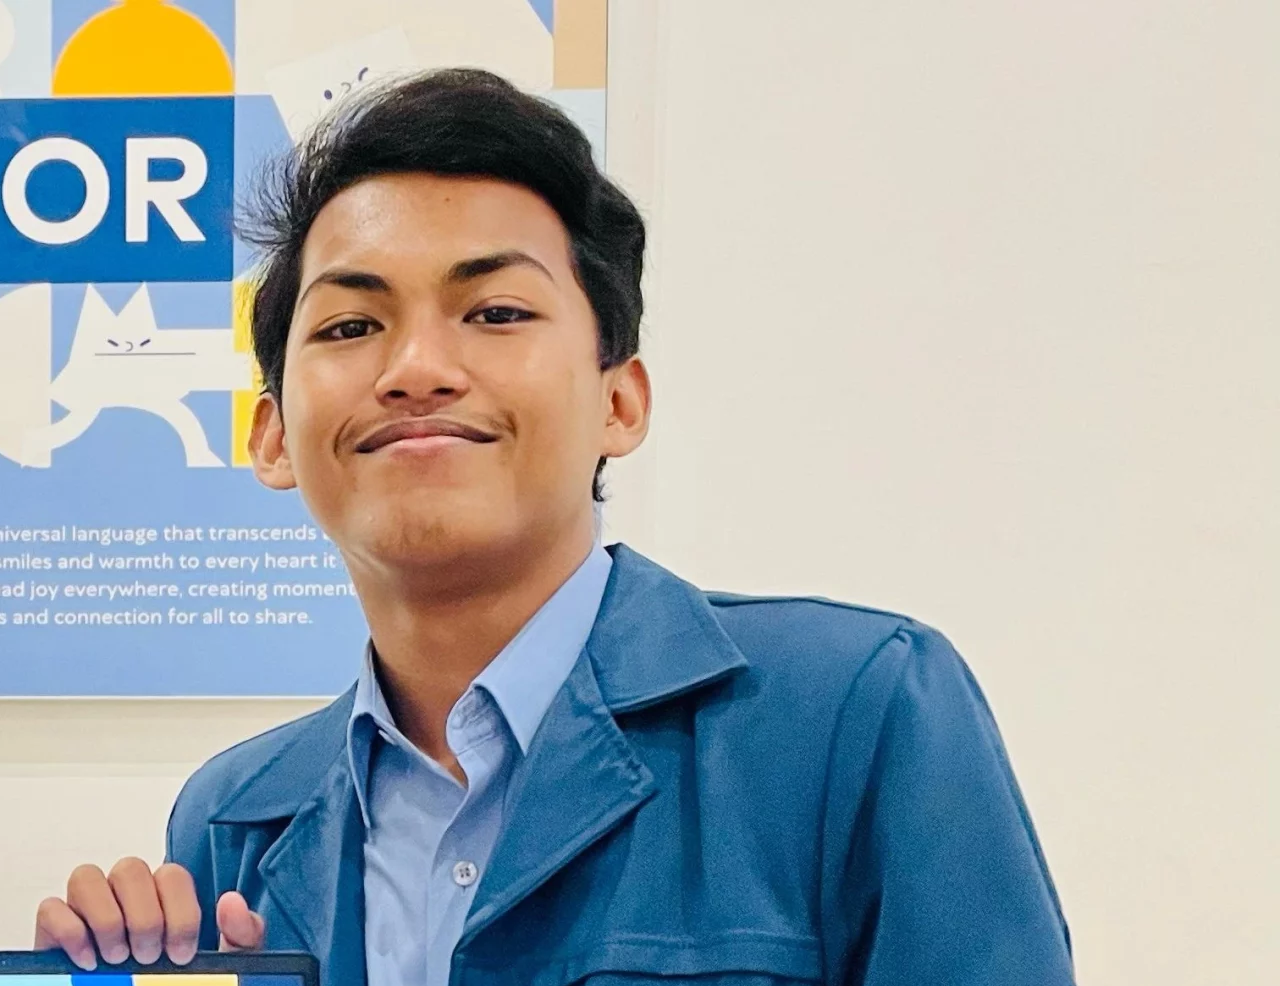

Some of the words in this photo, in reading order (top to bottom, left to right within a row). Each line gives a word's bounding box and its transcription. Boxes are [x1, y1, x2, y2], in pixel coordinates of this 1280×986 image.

[71, 525, 158, 546] language
[163, 524, 204, 542] that
[208, 524, 317, 541] transcends
[57, 552, 94, 569] and
[98, 552, 174, 569] warmth
[178, 554, 200, 569] to
[205, 556, 260, 573] every
[264, 552, 318, 569] heart
[323, 552, 337, 568] it
[29, 581, 59, 601] joy
[63, 580, 183, 601] everywhere,
[188, 580, 268, 601] creating
[12, 608, 49, 625] and
[53, 608, 162, 625] connection
[167, 607, 199, 625] for
[202, 607, 224, 625] all
[228, 611, 250, 625] to
[254, 608, 314, 625] share.
